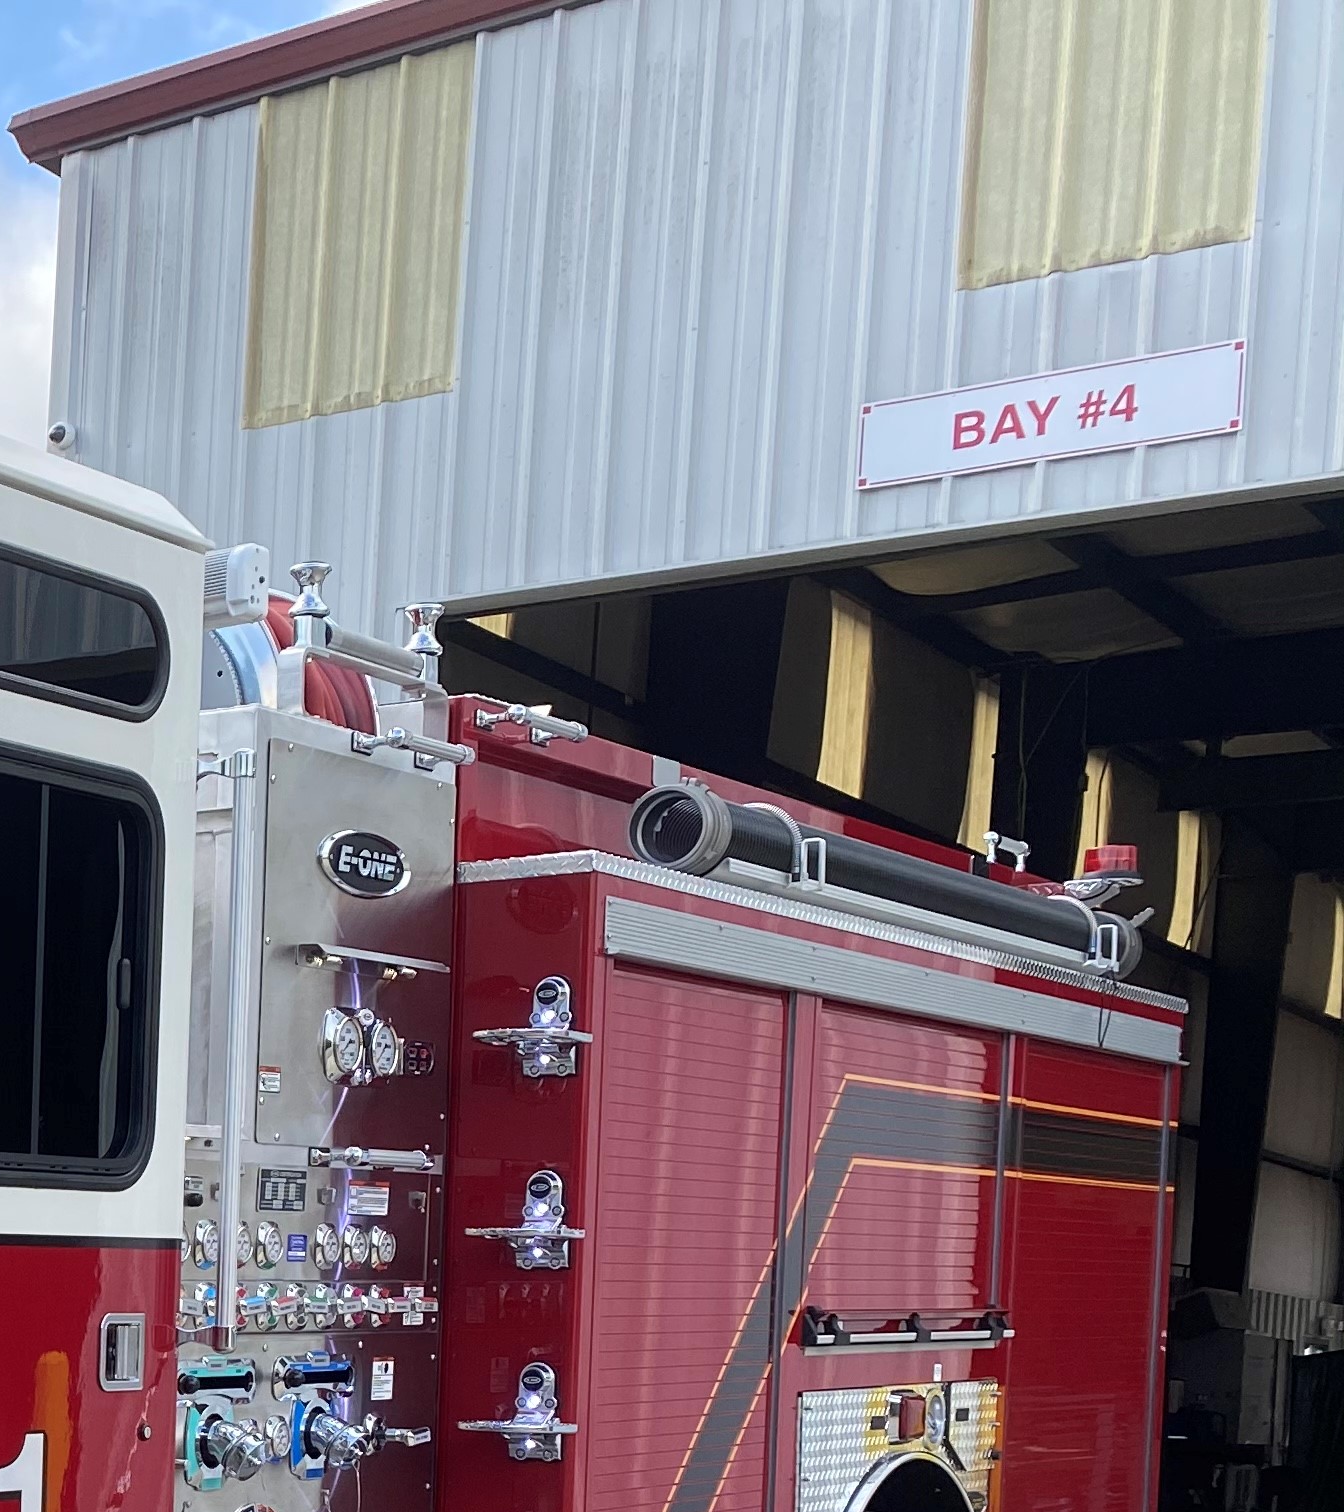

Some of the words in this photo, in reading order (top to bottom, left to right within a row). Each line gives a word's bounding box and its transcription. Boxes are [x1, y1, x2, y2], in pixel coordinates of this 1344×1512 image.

[952, 395, 1060, 450] BAY
[1077, 383, 1139, 430] #4
[338, 845, 397, 881] E-ONE
